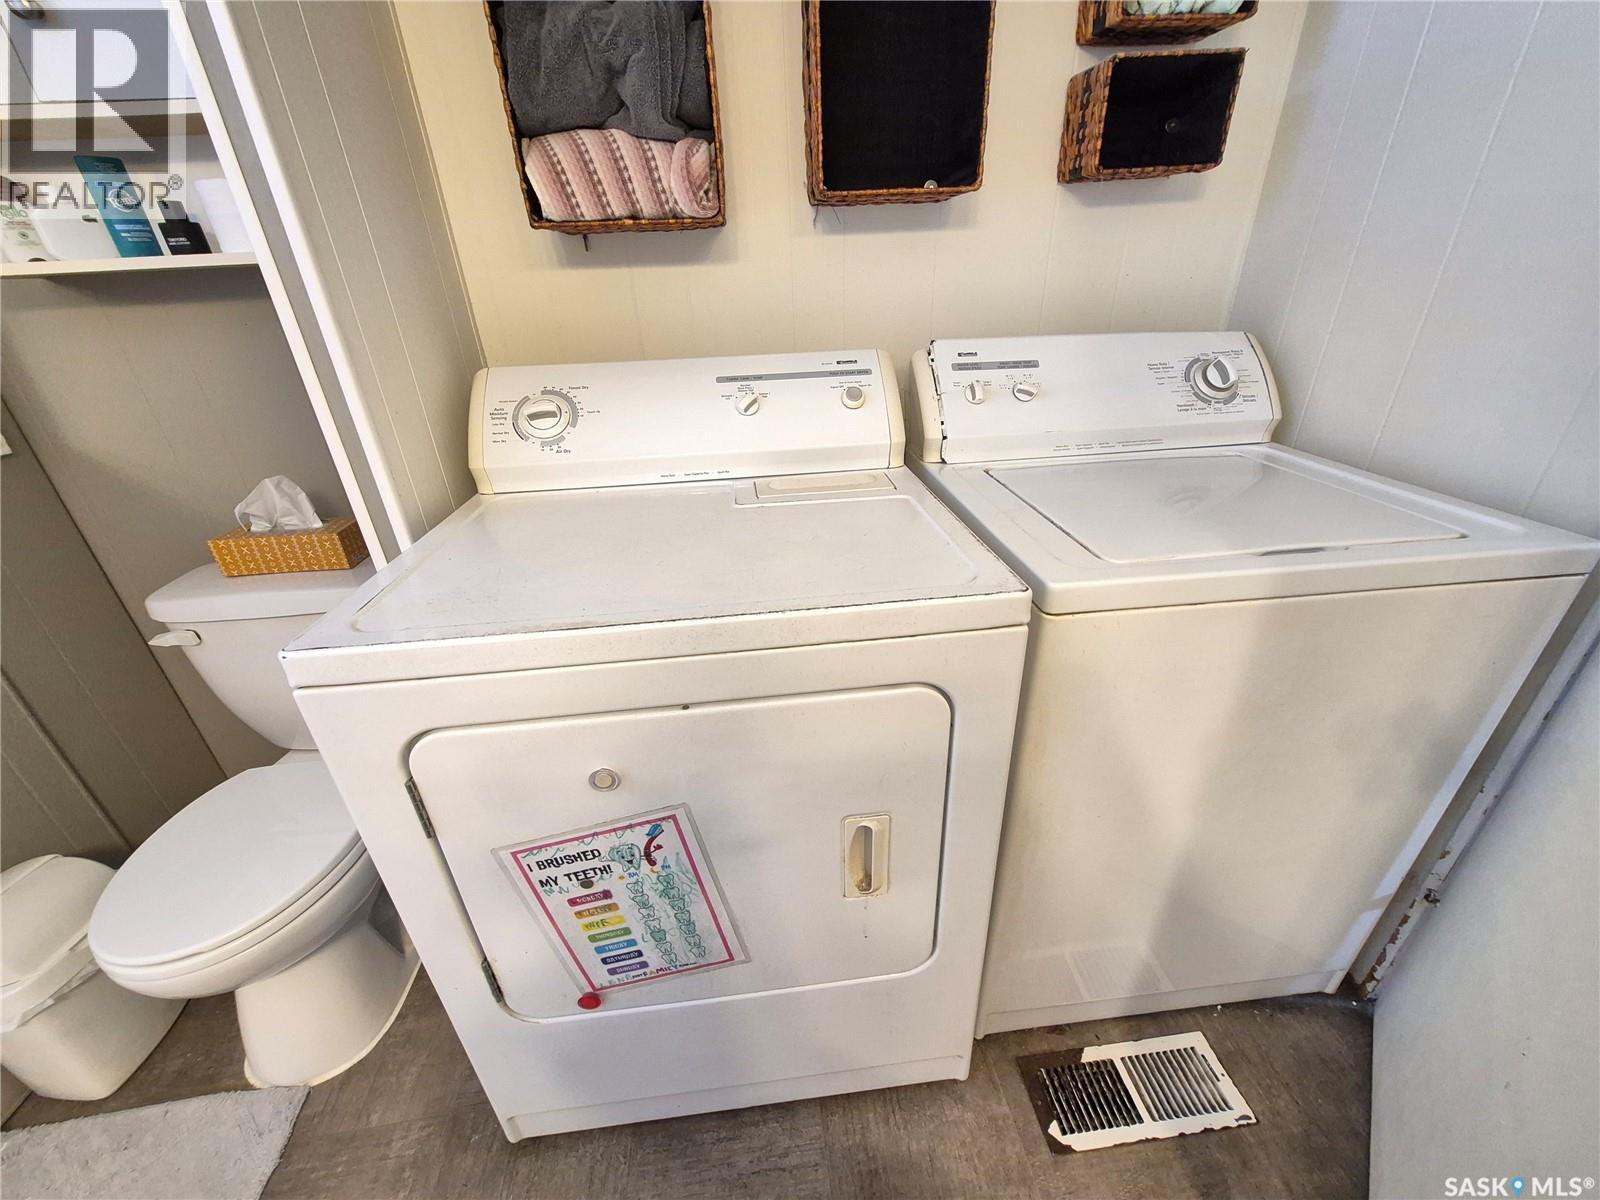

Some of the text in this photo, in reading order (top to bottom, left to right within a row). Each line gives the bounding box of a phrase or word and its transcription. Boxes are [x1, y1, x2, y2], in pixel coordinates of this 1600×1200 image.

[526, 848, 603, 872] I BRUSHED
[538, 864, 614, 889] MY TEETH!
[606, 951, 639, 963] SATURDAY
[615, 963, 641, 973] SUNDAY
